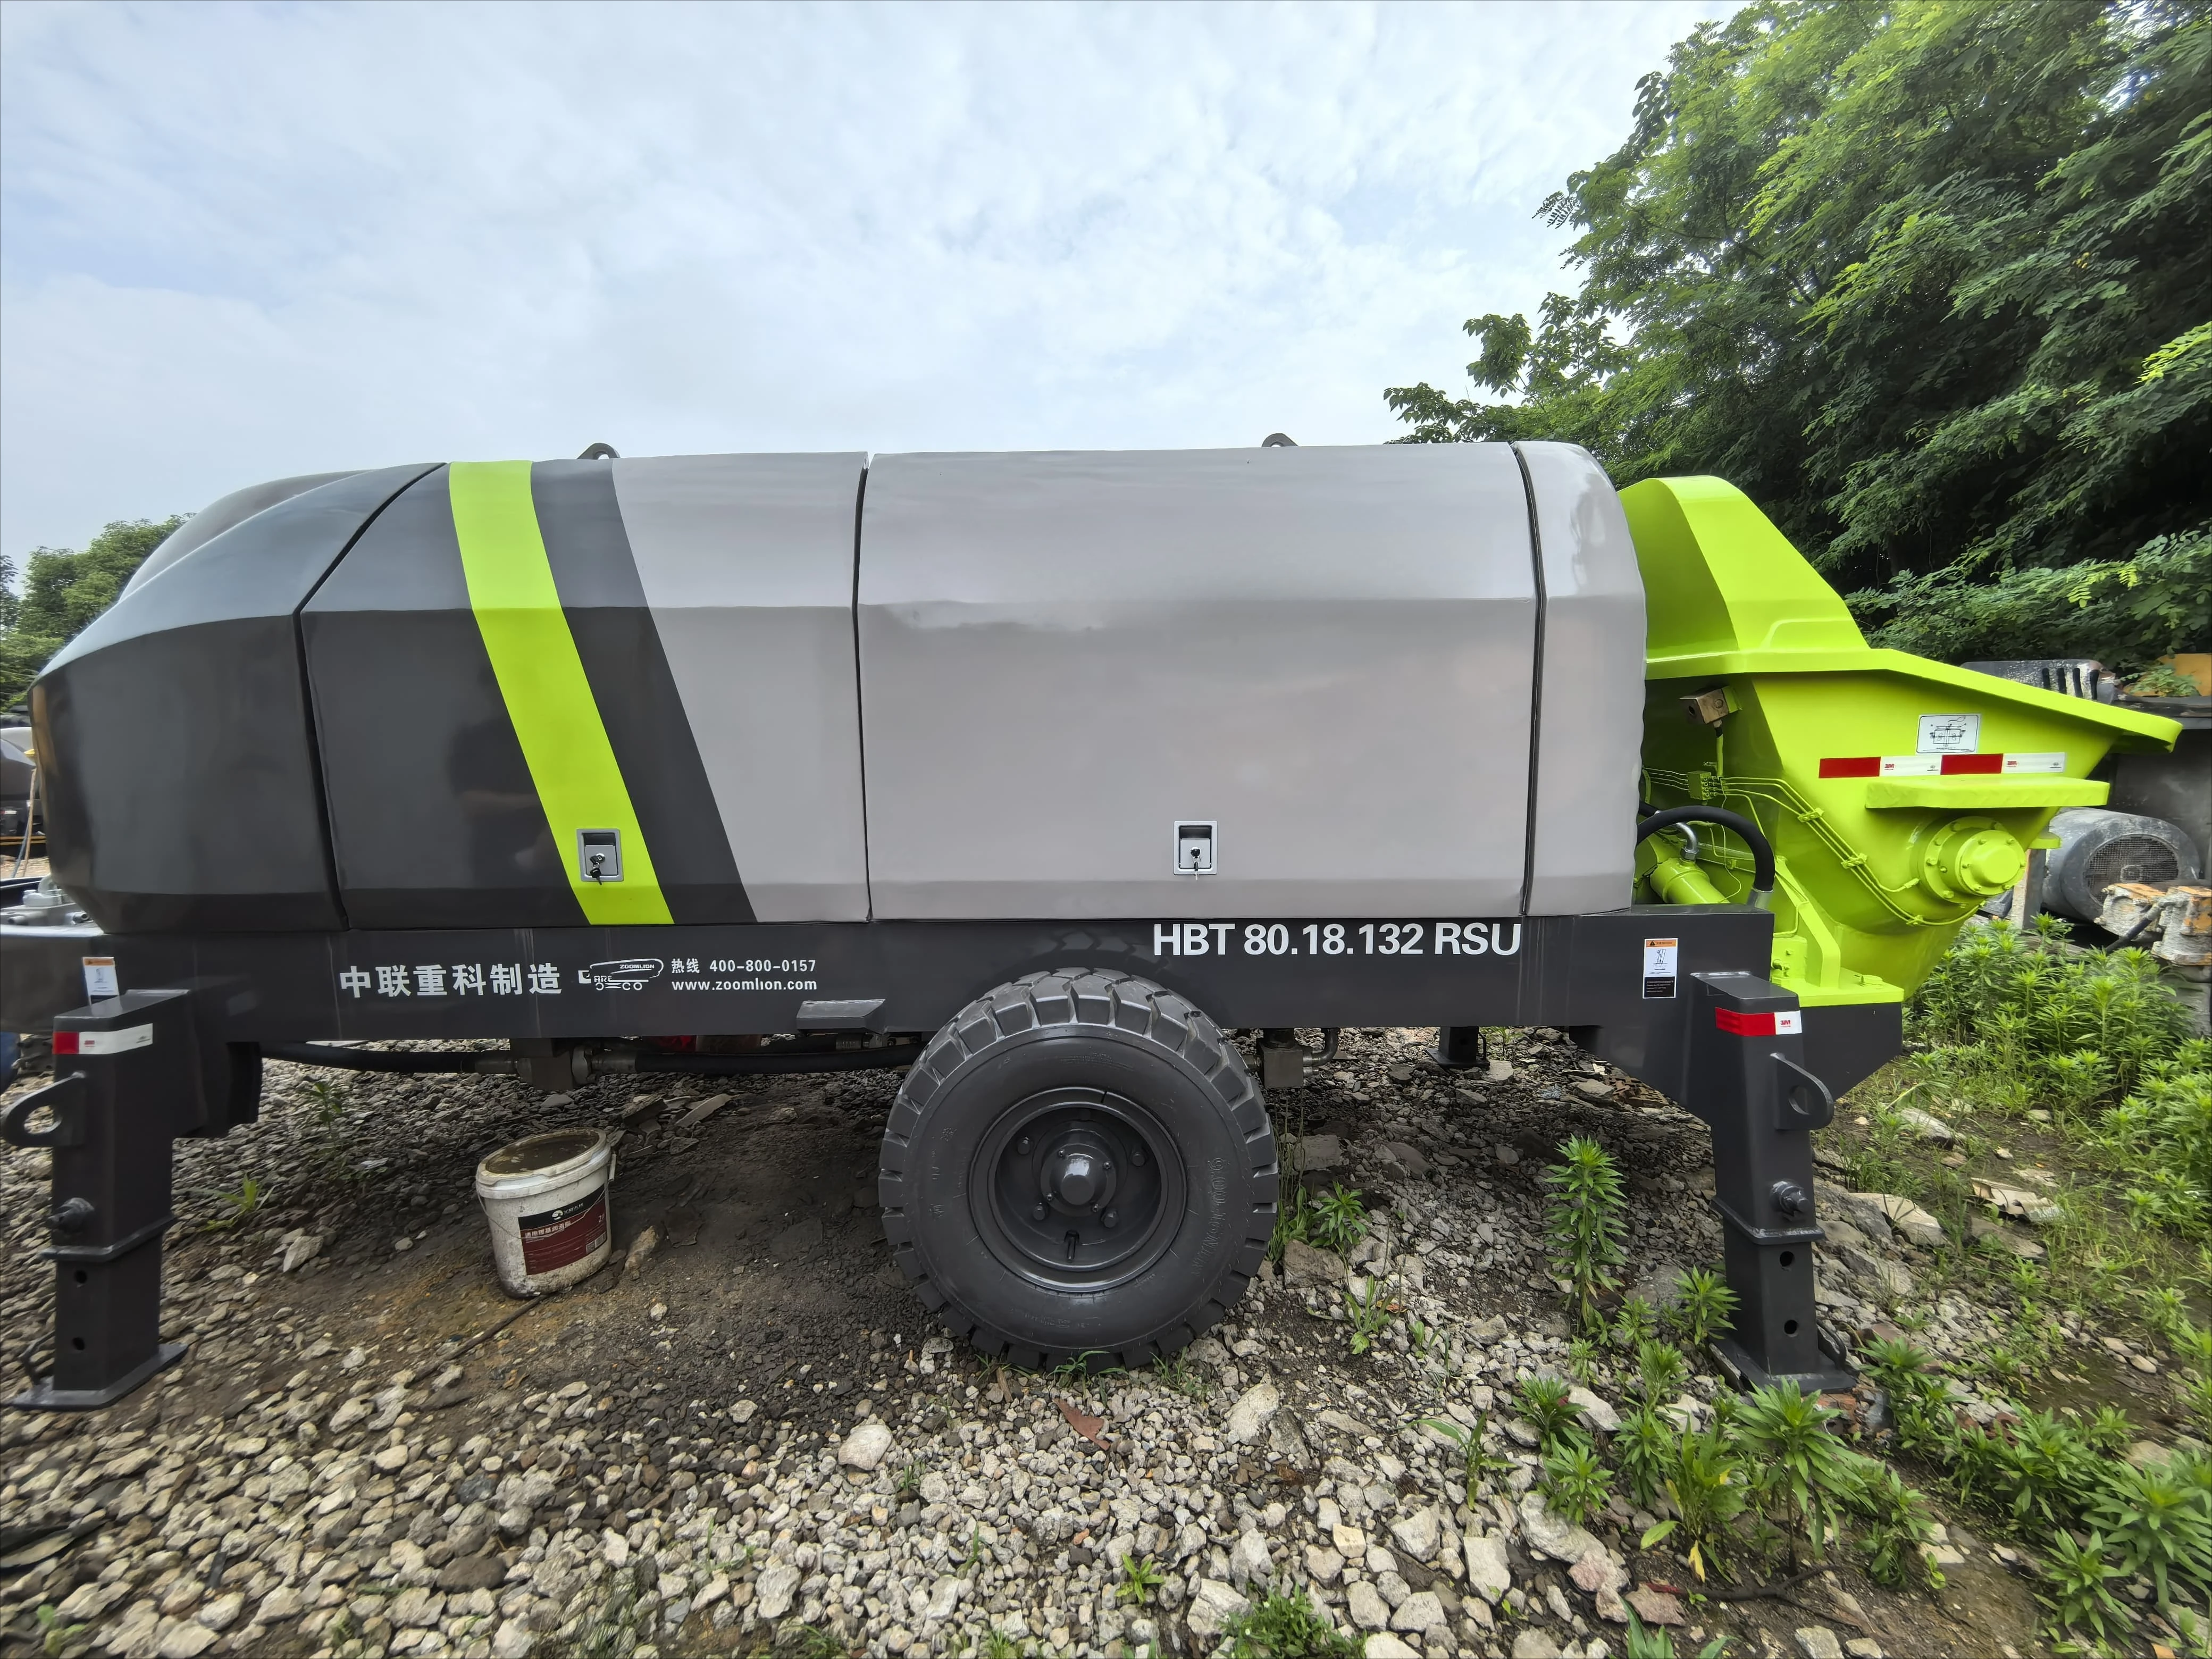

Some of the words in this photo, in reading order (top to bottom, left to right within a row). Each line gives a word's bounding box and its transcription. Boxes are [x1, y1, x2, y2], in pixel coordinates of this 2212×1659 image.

[1154, 923, 1235, 956] HBT
[1244, 923, 1423, 955] 80.18.132
[1435, 923, 1521, 956] RSU
[671, 958, 700, 974] 热线
[709, 959, 816, 972] 400-800-0157
[340, 962, 562, 998] 中联重科制造
[671, 977, 817, 991] www.zoomlion.com
